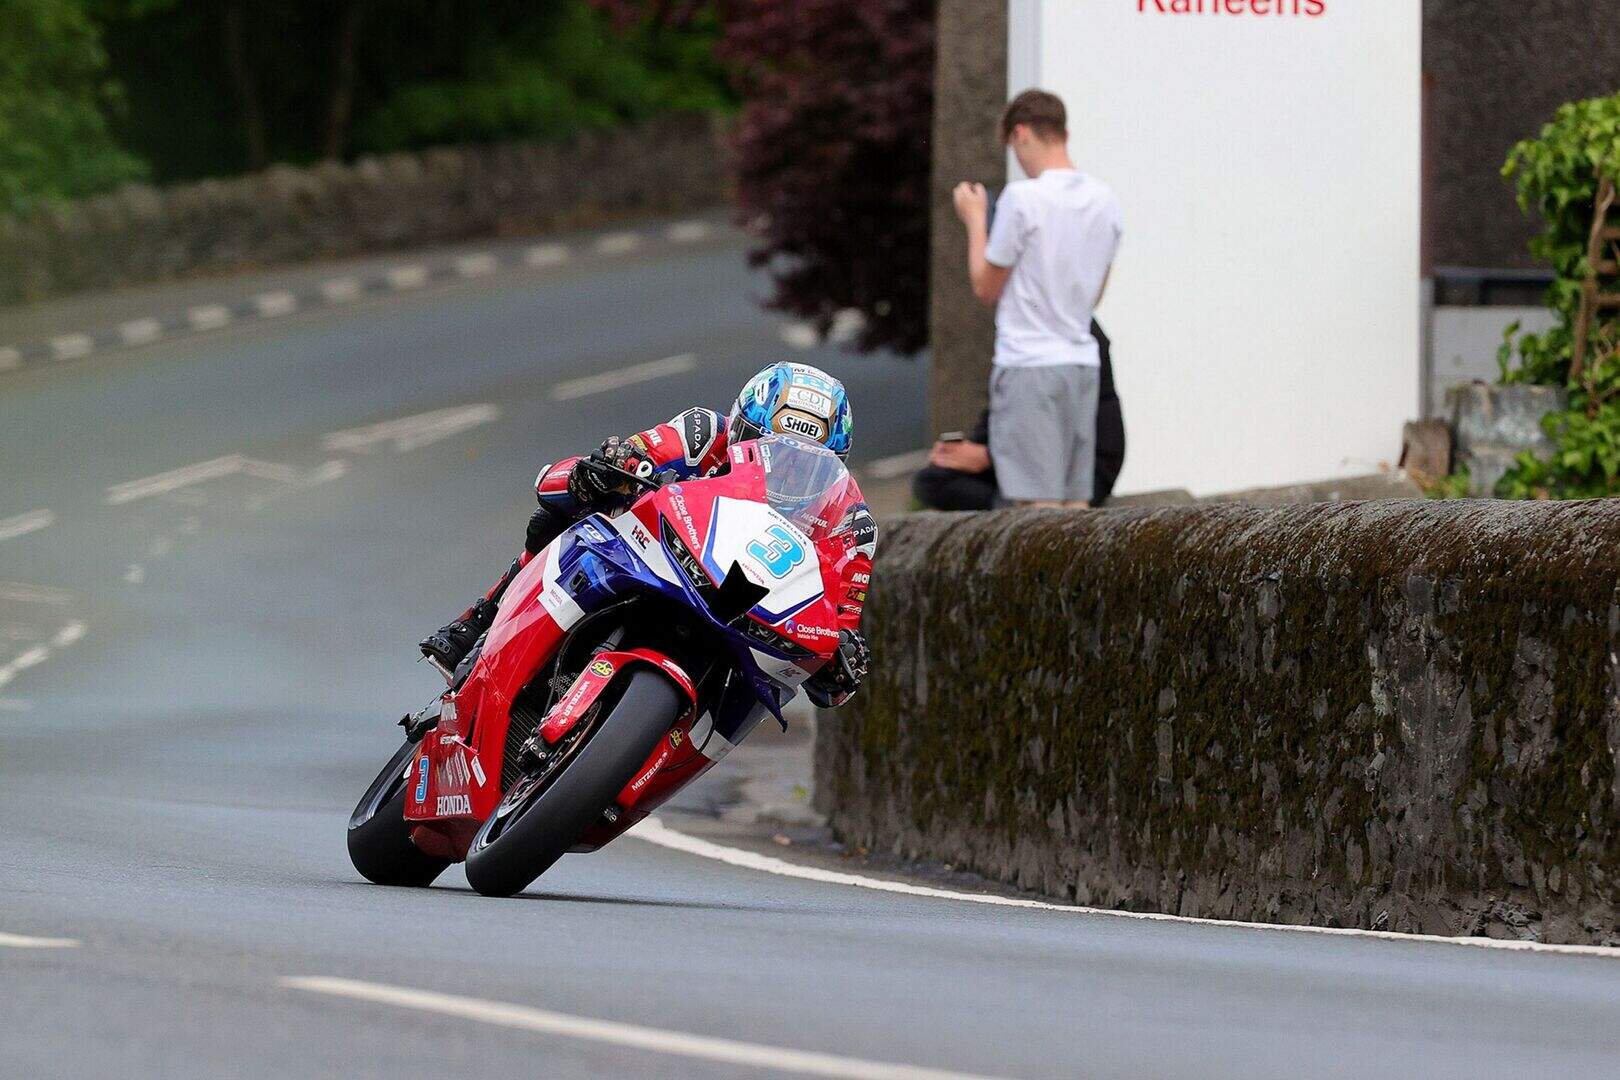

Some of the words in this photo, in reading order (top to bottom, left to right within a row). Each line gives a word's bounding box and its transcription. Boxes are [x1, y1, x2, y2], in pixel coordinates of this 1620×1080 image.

[692, 413, 702, 450] SPADA
[785, 416, 819, 437] SHOEI
[675, 494, 688, 515] Close
[683, 515, 702, 550] Brothers
[801, 511, 828, 528] MOTUL
[852, 524, 877, 537] PADA
[631, 525, 650, 550] HRC
[746, 524, 805, 579] 3
[797, 623, 816, 635] Close
[816, 626, 840, 639] Brothers
[631, 758, 662, 791] METZELER
[436, 794, 472, 816] HONDA
